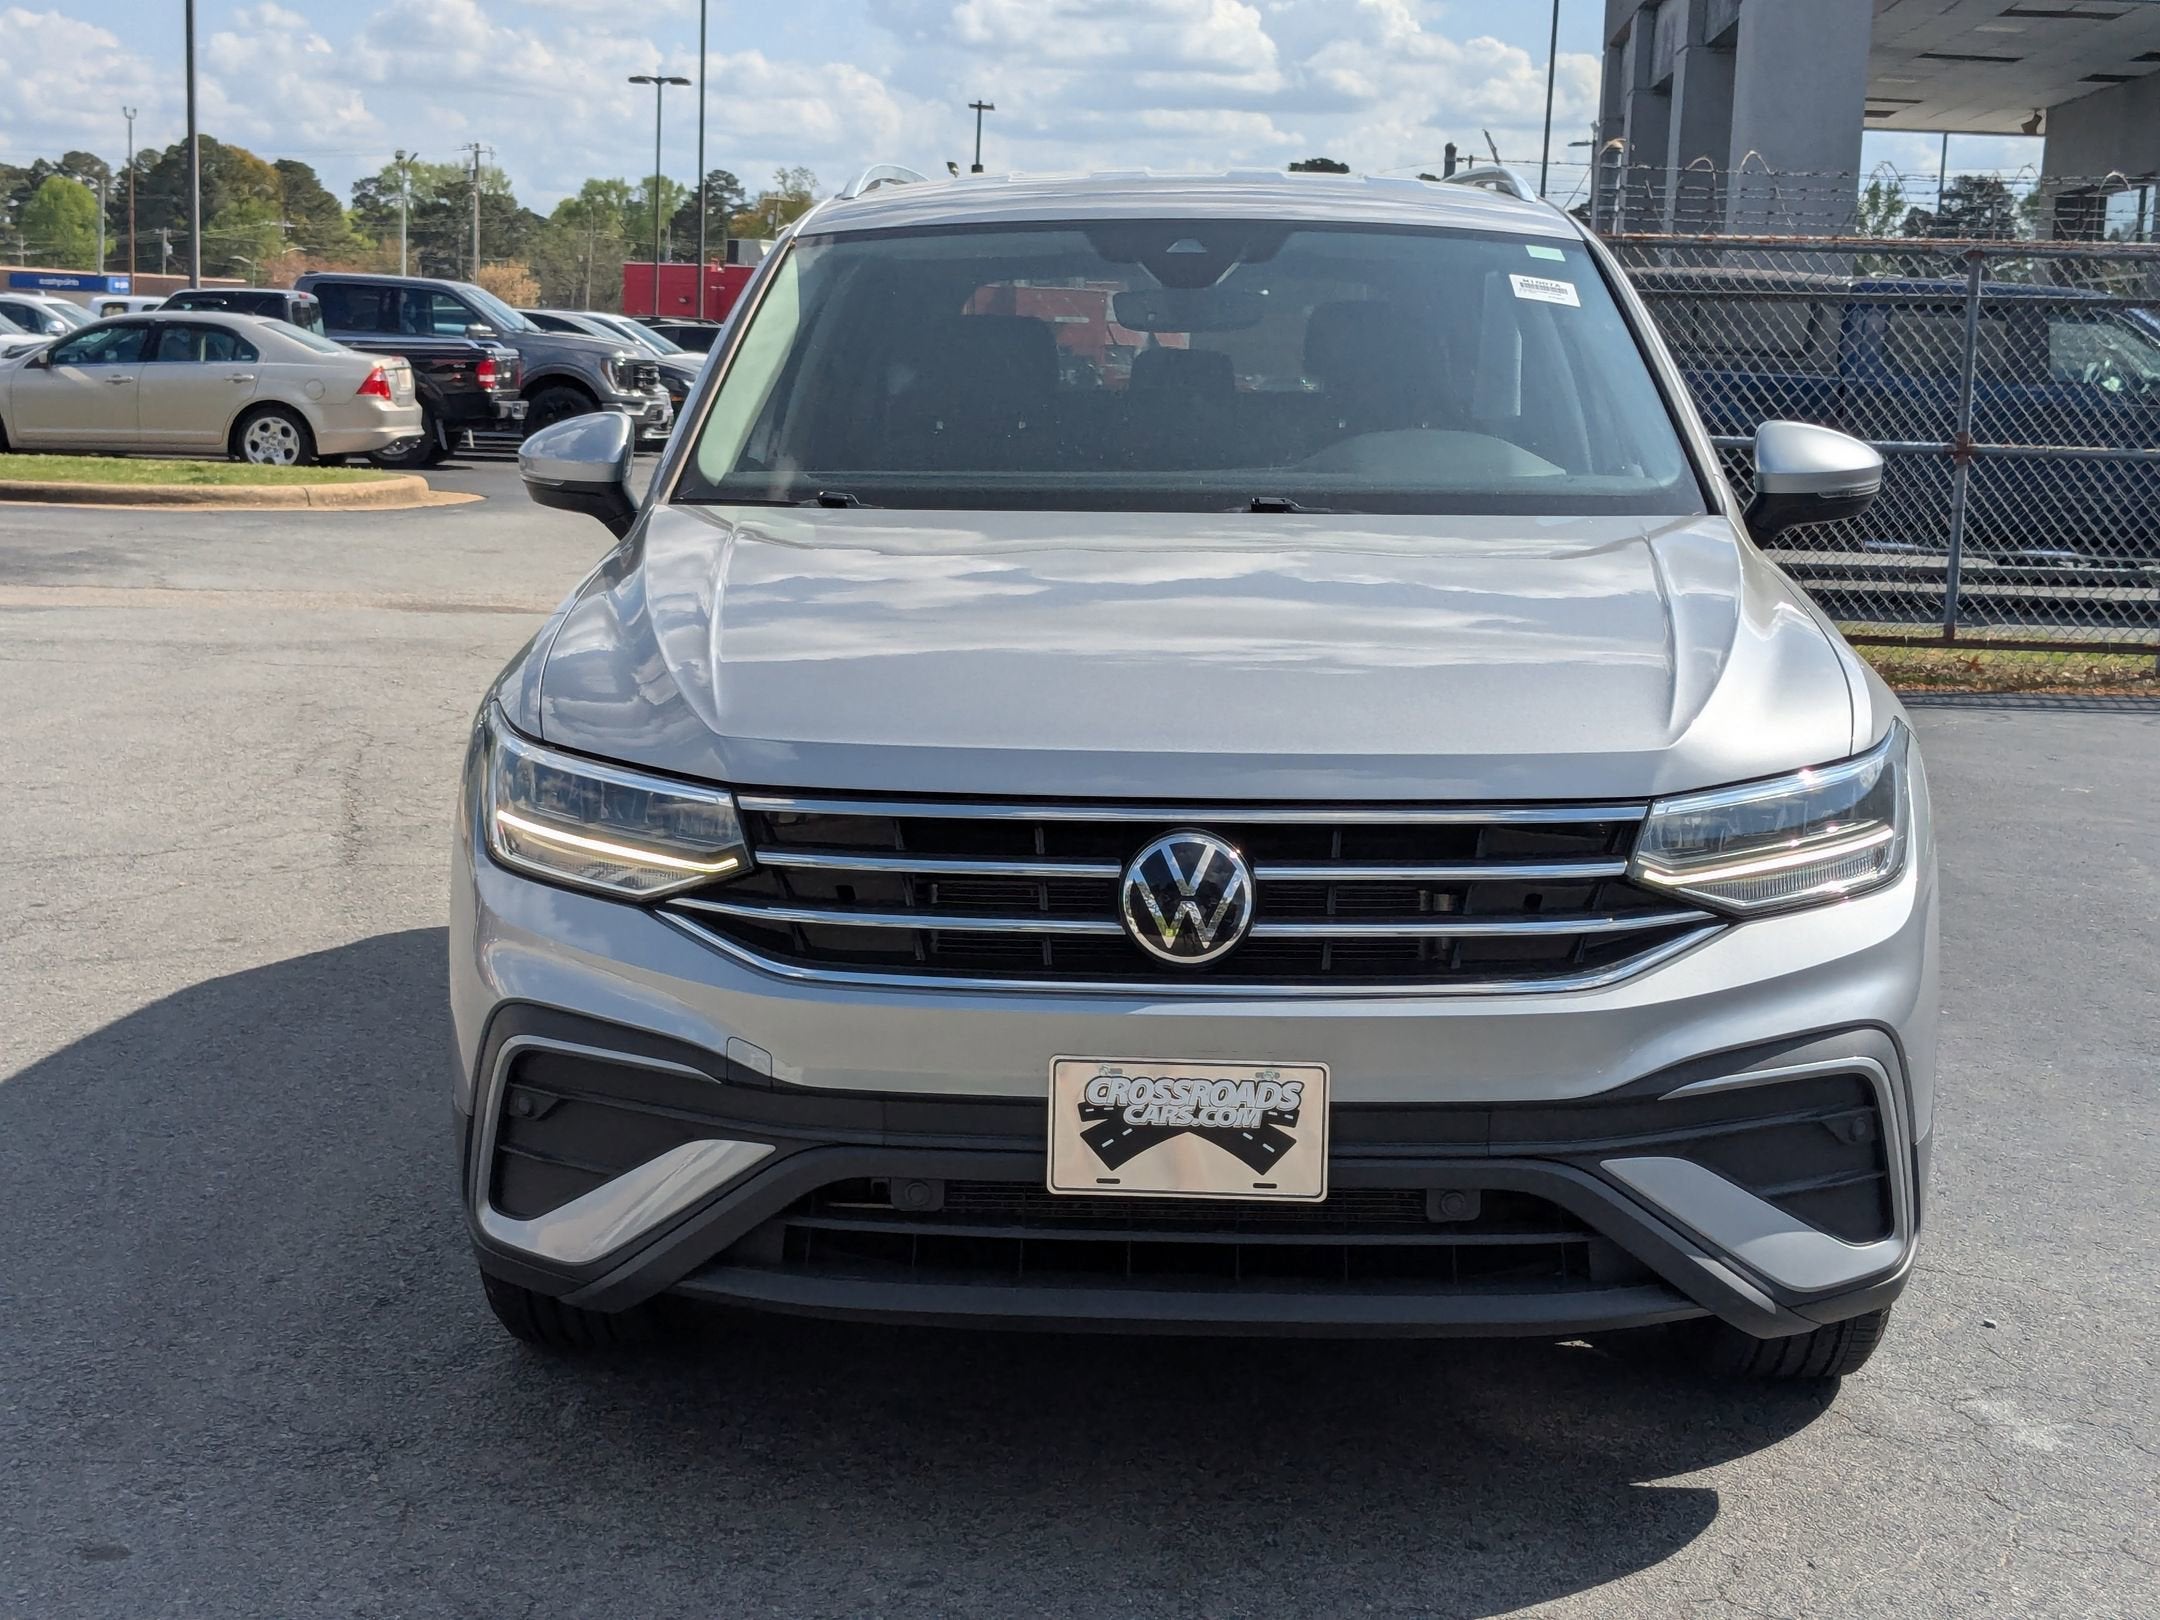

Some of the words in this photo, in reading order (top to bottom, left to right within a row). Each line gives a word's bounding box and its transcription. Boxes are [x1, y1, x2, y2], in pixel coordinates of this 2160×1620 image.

[1131, 843, 1244, 949] VW
[1085, 1076, 1305, 1110] CROSSROADS
[1122, 1105, 1262, 1128] CARS.COM
